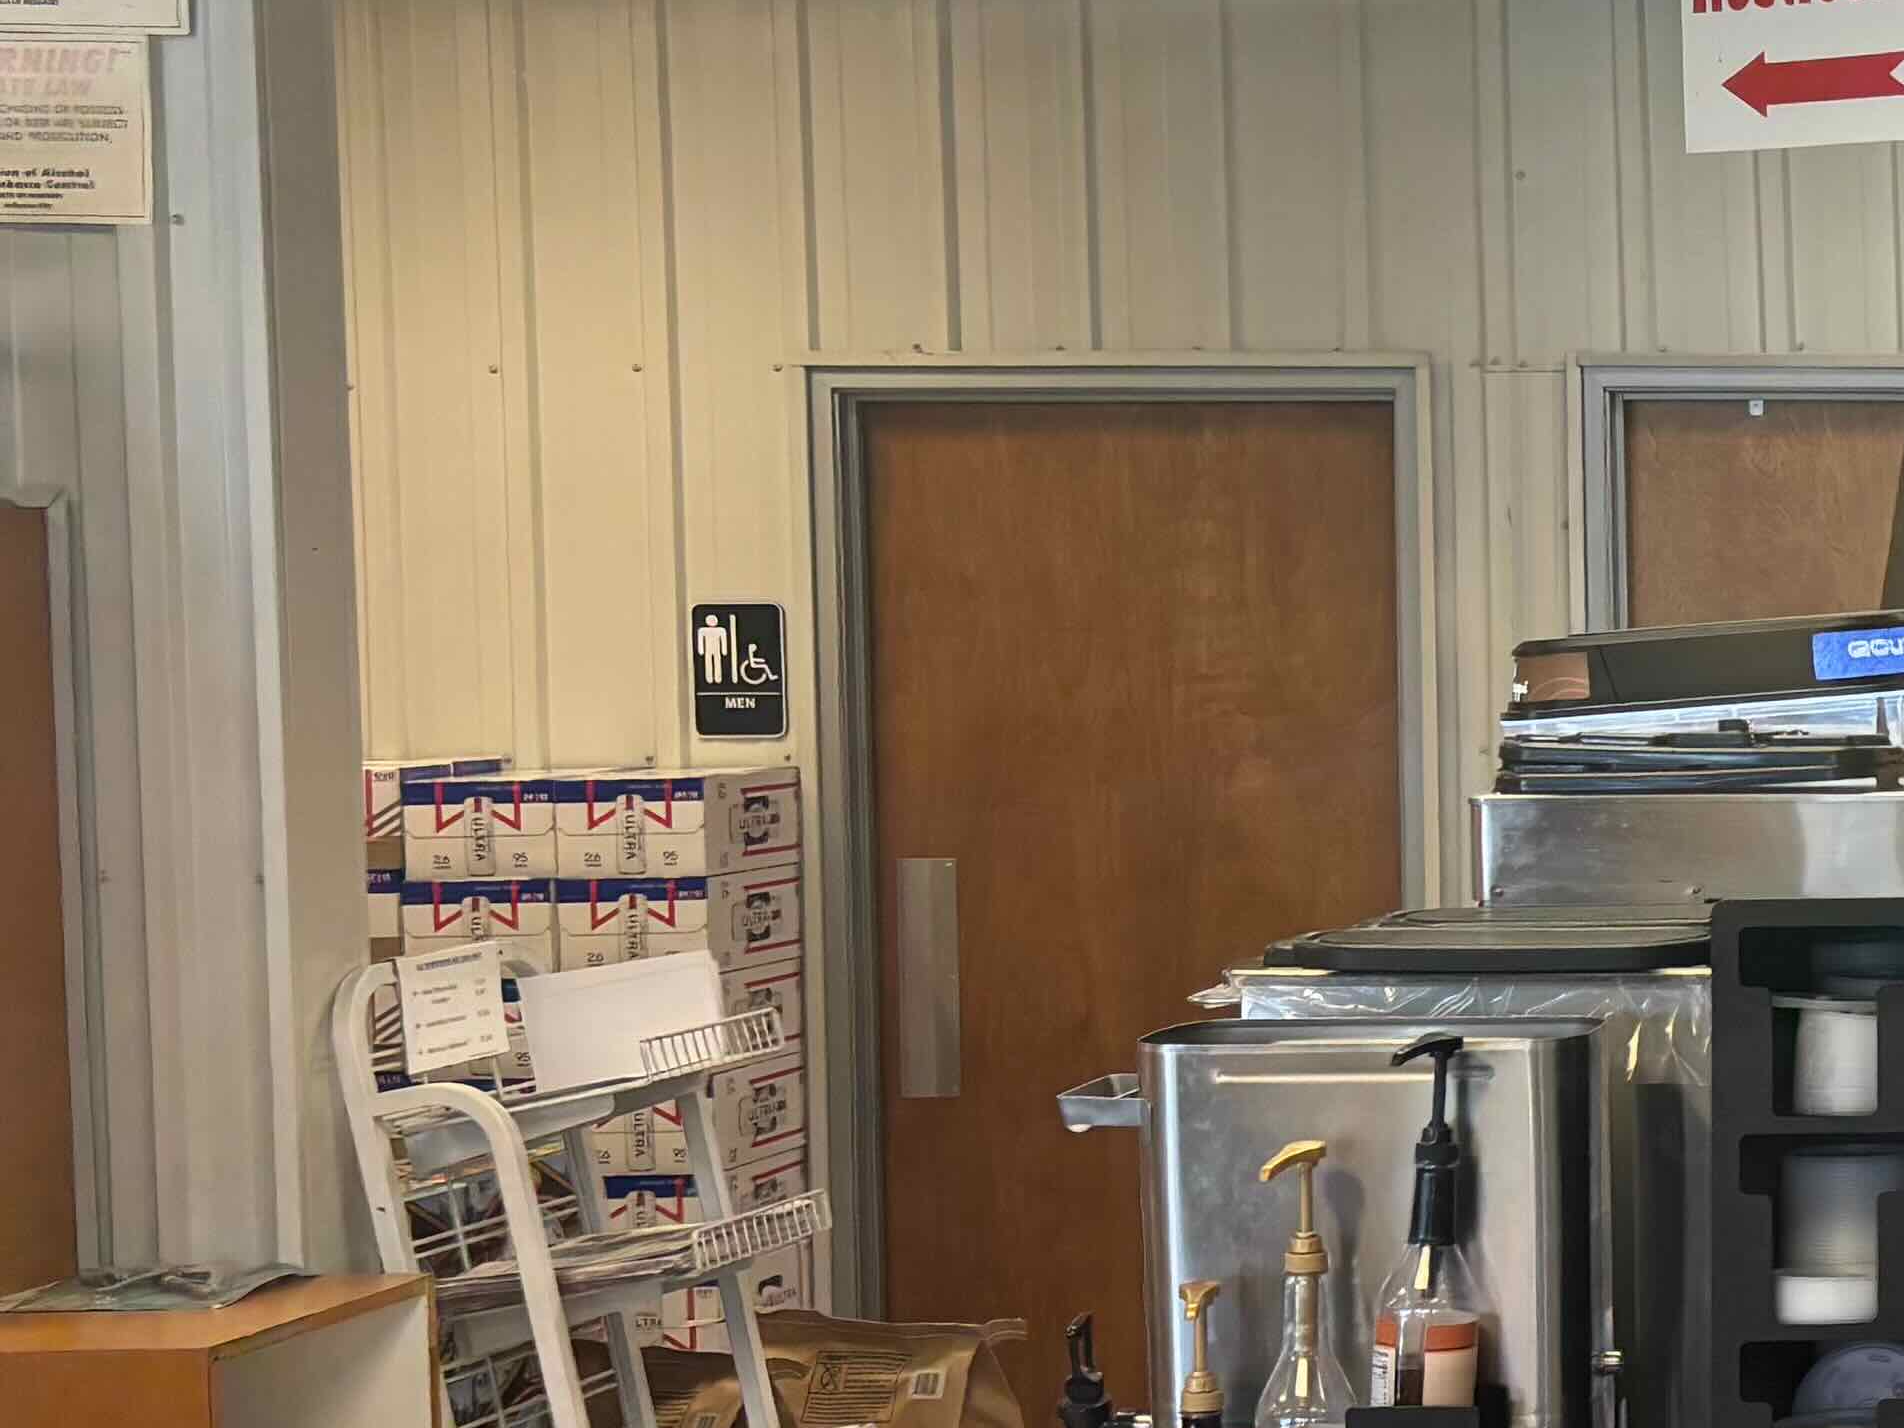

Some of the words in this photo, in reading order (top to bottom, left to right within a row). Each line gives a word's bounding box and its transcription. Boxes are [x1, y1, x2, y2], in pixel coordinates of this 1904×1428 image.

[725, 697, 756, 709] MEN
[471, 816, 487, 861] ULTRA
[624, 814, 637, 860] ULTRA
